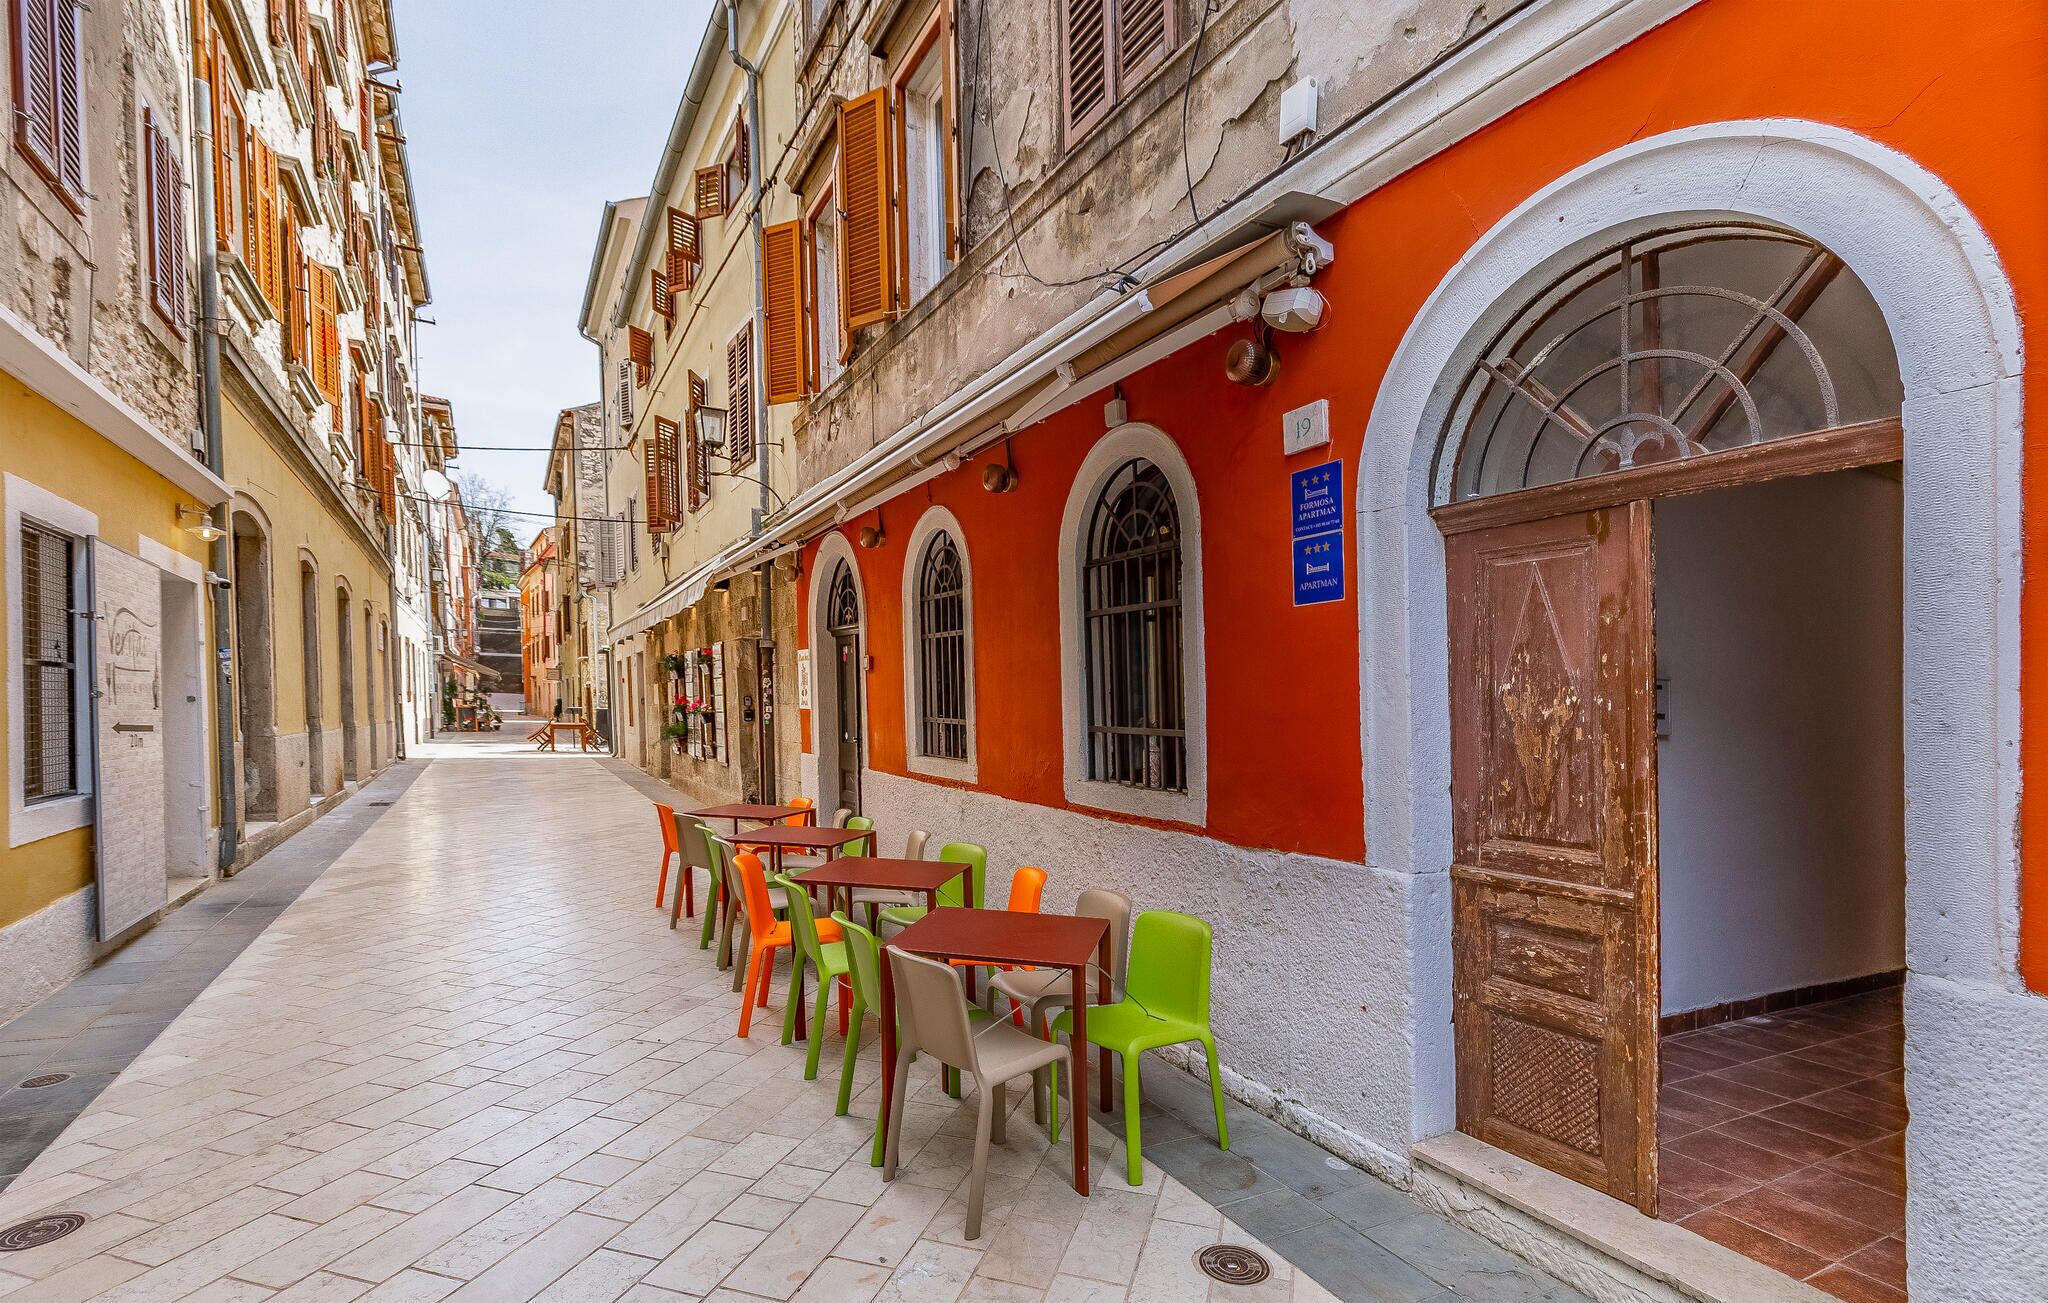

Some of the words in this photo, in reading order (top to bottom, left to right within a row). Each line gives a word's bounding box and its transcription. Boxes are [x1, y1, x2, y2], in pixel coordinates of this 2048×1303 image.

[1296, 417, 1311, 439] 19
[1300, 497, 1334, 511] FORMOSA
[1299, 506, 1336, 521] APARTMAN
[1300, 577, 1338, 591] APARTMAN
